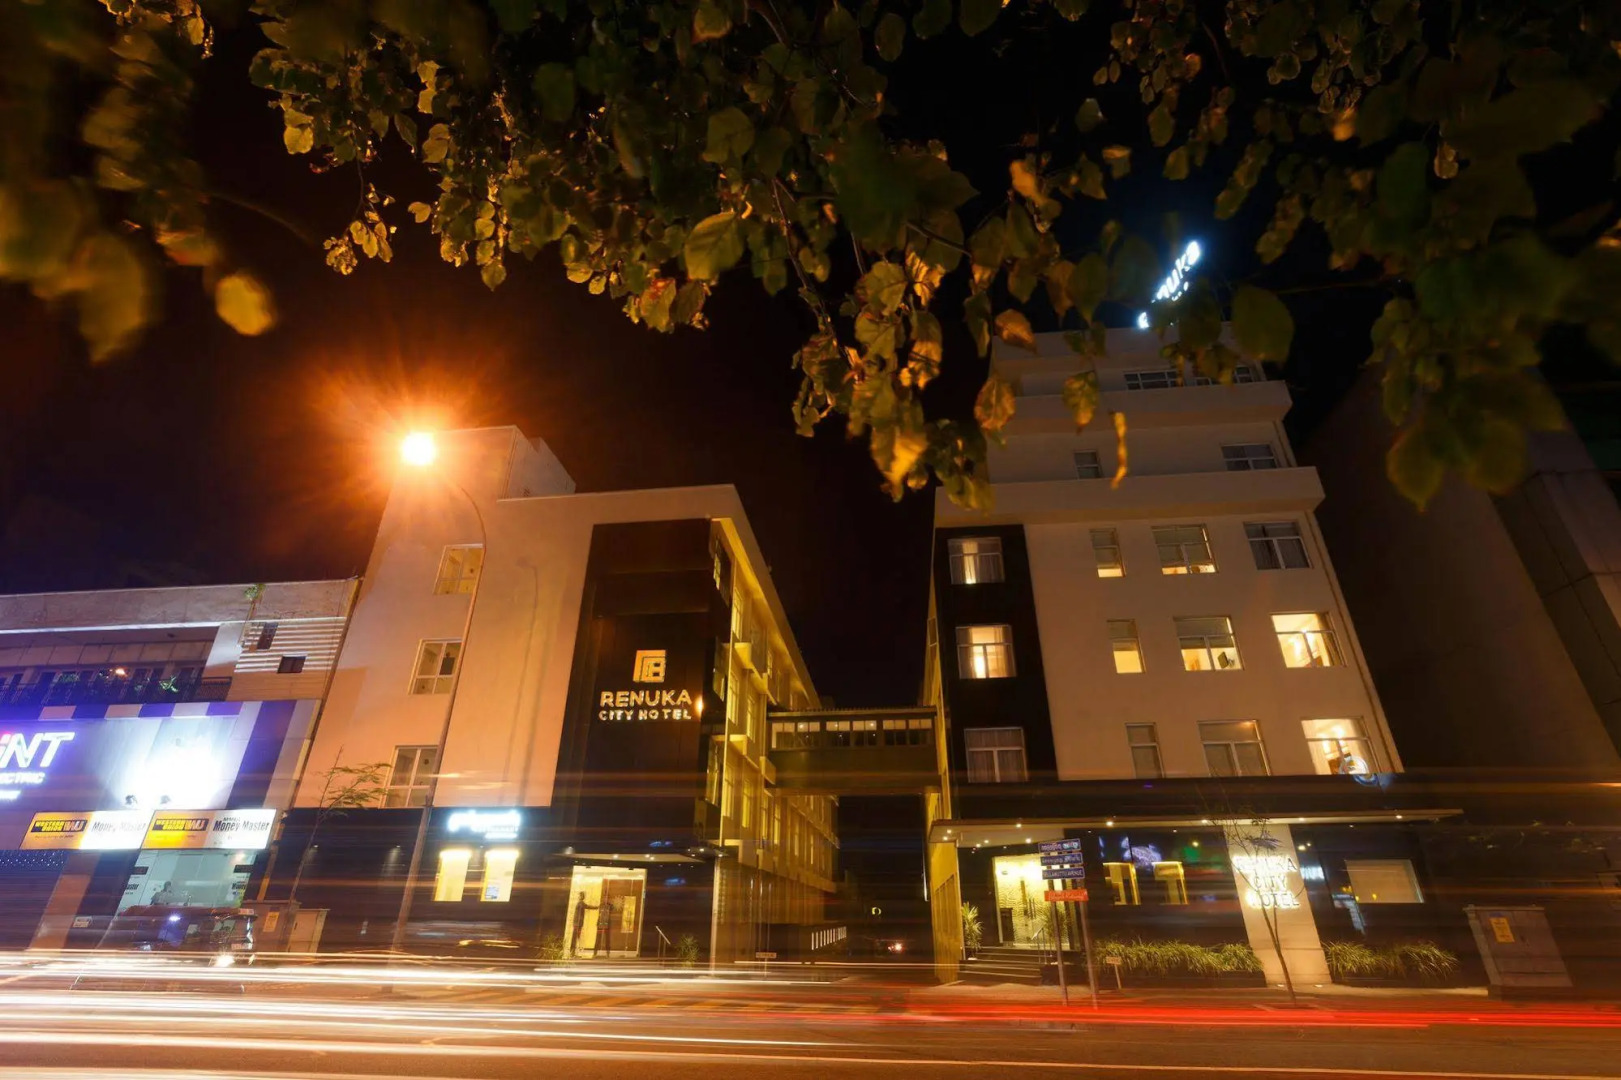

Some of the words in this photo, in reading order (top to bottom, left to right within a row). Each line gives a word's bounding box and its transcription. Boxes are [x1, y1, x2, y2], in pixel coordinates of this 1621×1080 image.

[600, 689, 692, 708] RENUKA
[598, 709, 634, 721] CITY
[638, 708, 692, 720] HOTEL
[213, 820, 241, 832] Money
[242, 820, 270, 832] Master
[1253, 875, 1286, 889] CITY
